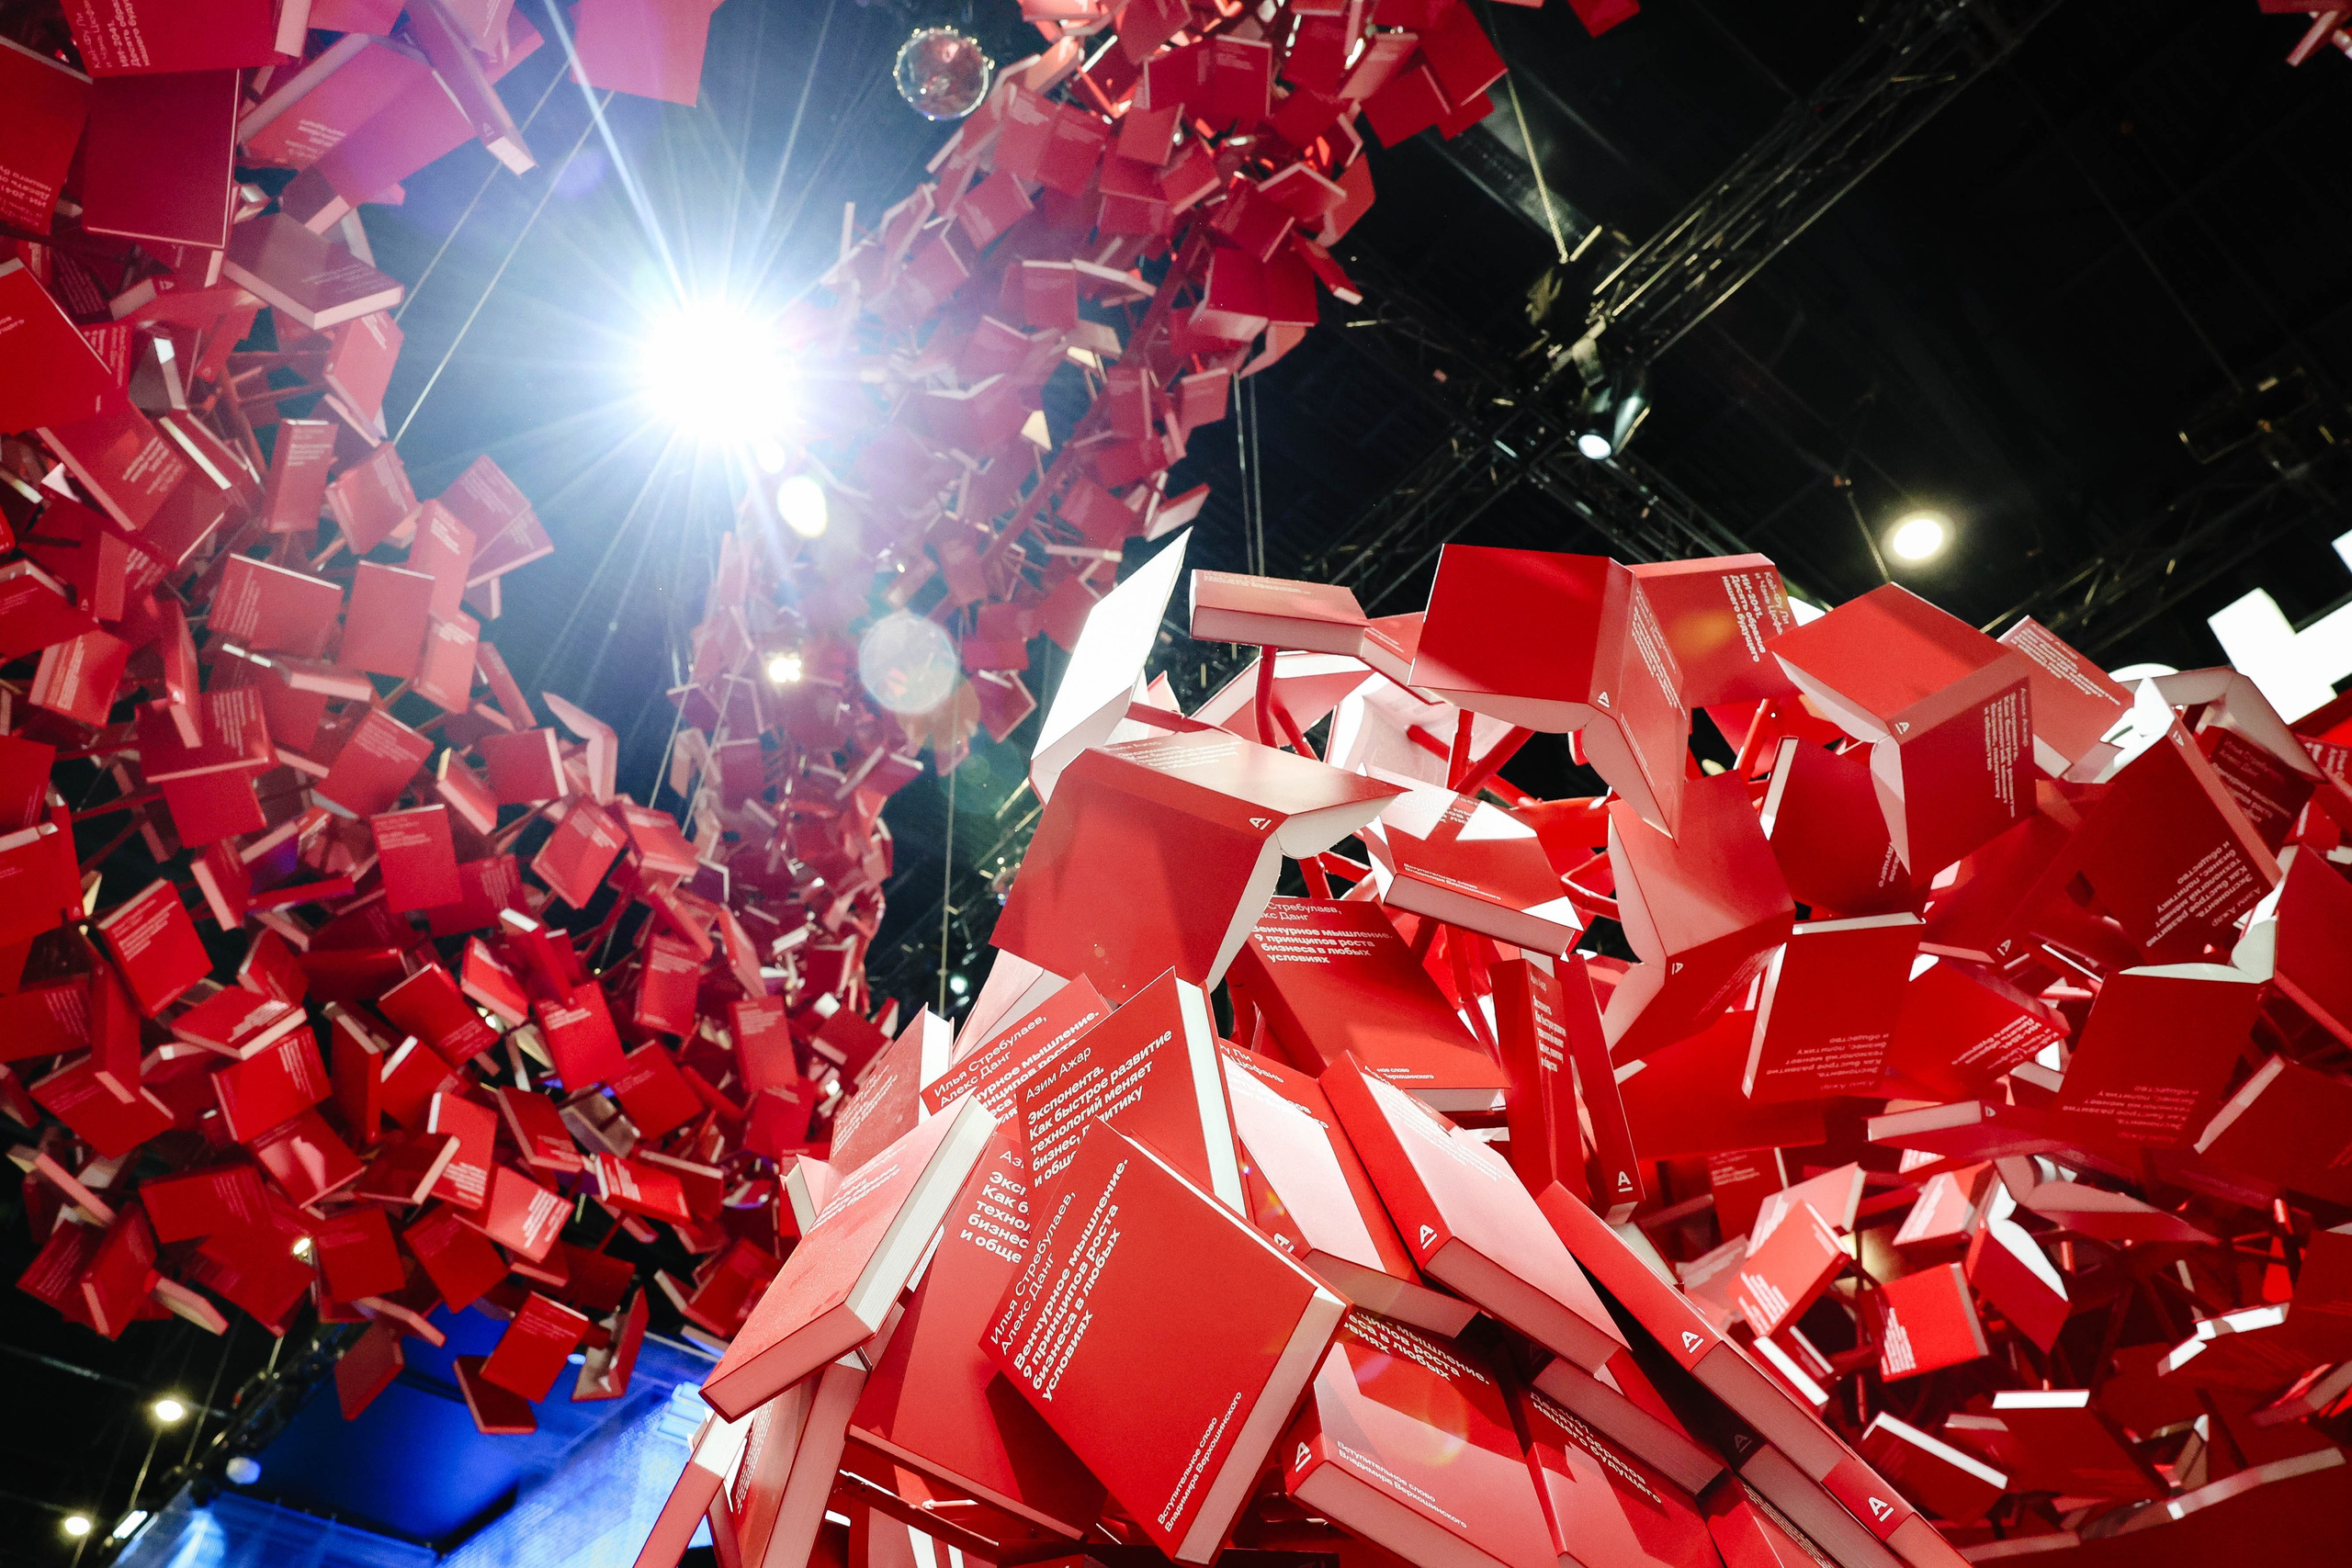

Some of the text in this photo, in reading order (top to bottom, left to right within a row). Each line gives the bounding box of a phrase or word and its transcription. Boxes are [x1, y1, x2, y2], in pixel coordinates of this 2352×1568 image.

[1768, 604, 1782, 636] Цюфа
[1250, 818, 1272, 829] А
[1268, 902, 1342, 915] Стребулаев,
[1279, 911, 1308, 920] Данг
[1254, 934, 1374, 948] 9 принципов роста
[1261, 943, 1317, 953] бизнеса
[1267, 954, 1330, 963] условиях
[934, 1017, 1046, 1097] Илья Стребулаев,
[975, 1012, 1099, 1102] чурное мышление.
[1026, 1047, 1091, 1102] Азим Ажар
[941, 1052, 1011, 1111] Алекс Данг
[1028, 1067, 1103, 1124] Экспонента.
[1030, 1031, 1171, 1141] Как быстрое развитие
[1031, 1061, 1152, 1156] технологий меняет
[1000, 1151, 1023, 1168] Аз
[1033, 1135, 1080, 1171] бизнес,
[982, 1185, 1016, 1208] Как
[1035, 1175, 1042, 1188] и
[1618, 1171, 1633, 1192] А
[968, 1213, 1029, 1248] бизнес
[977, 1200, 1031, 1233] технол
[1420, 1224, 1437, 1249] А
[976, 1236, 1022, 1263] обще
[991, 1192, 1075, 1344] Илья Стребулаев,
[1014, 1159, 1128, 1370] Венчурное мышление.
[1001, 1253, 1053, 1355] Алекс Данг
[1023, 1205, 1118, 1378] 9 принципов роста
[1033, 1228, 1121, 1389] бизнеса в любых
[1044, 1310, 1093, 1402] условиях
[1349, 1324, 1389, 1358] виях
[1358, 1314, 1413, 1353] ципов
[1413, 1344, 1460, 1377] роста
[1380, 1333, 1450, 1381] в любых
[1396, 1325, 1489, 1384] мышление.
[1682, 1332, 1703, 1353] А
[1158, 1417, 1216, 1524] Вступительное слово
[1165, 1393, 1241, 1532] Владимира Верхошинского
[1295, 1442, 1311, 1472] А
[1338, 1440, 1435, 1502] Вступительное слово
[1339, 1450, 1466, 1528] Владимира Верхошинского
[1869, 1497, 1894, 1521] А
